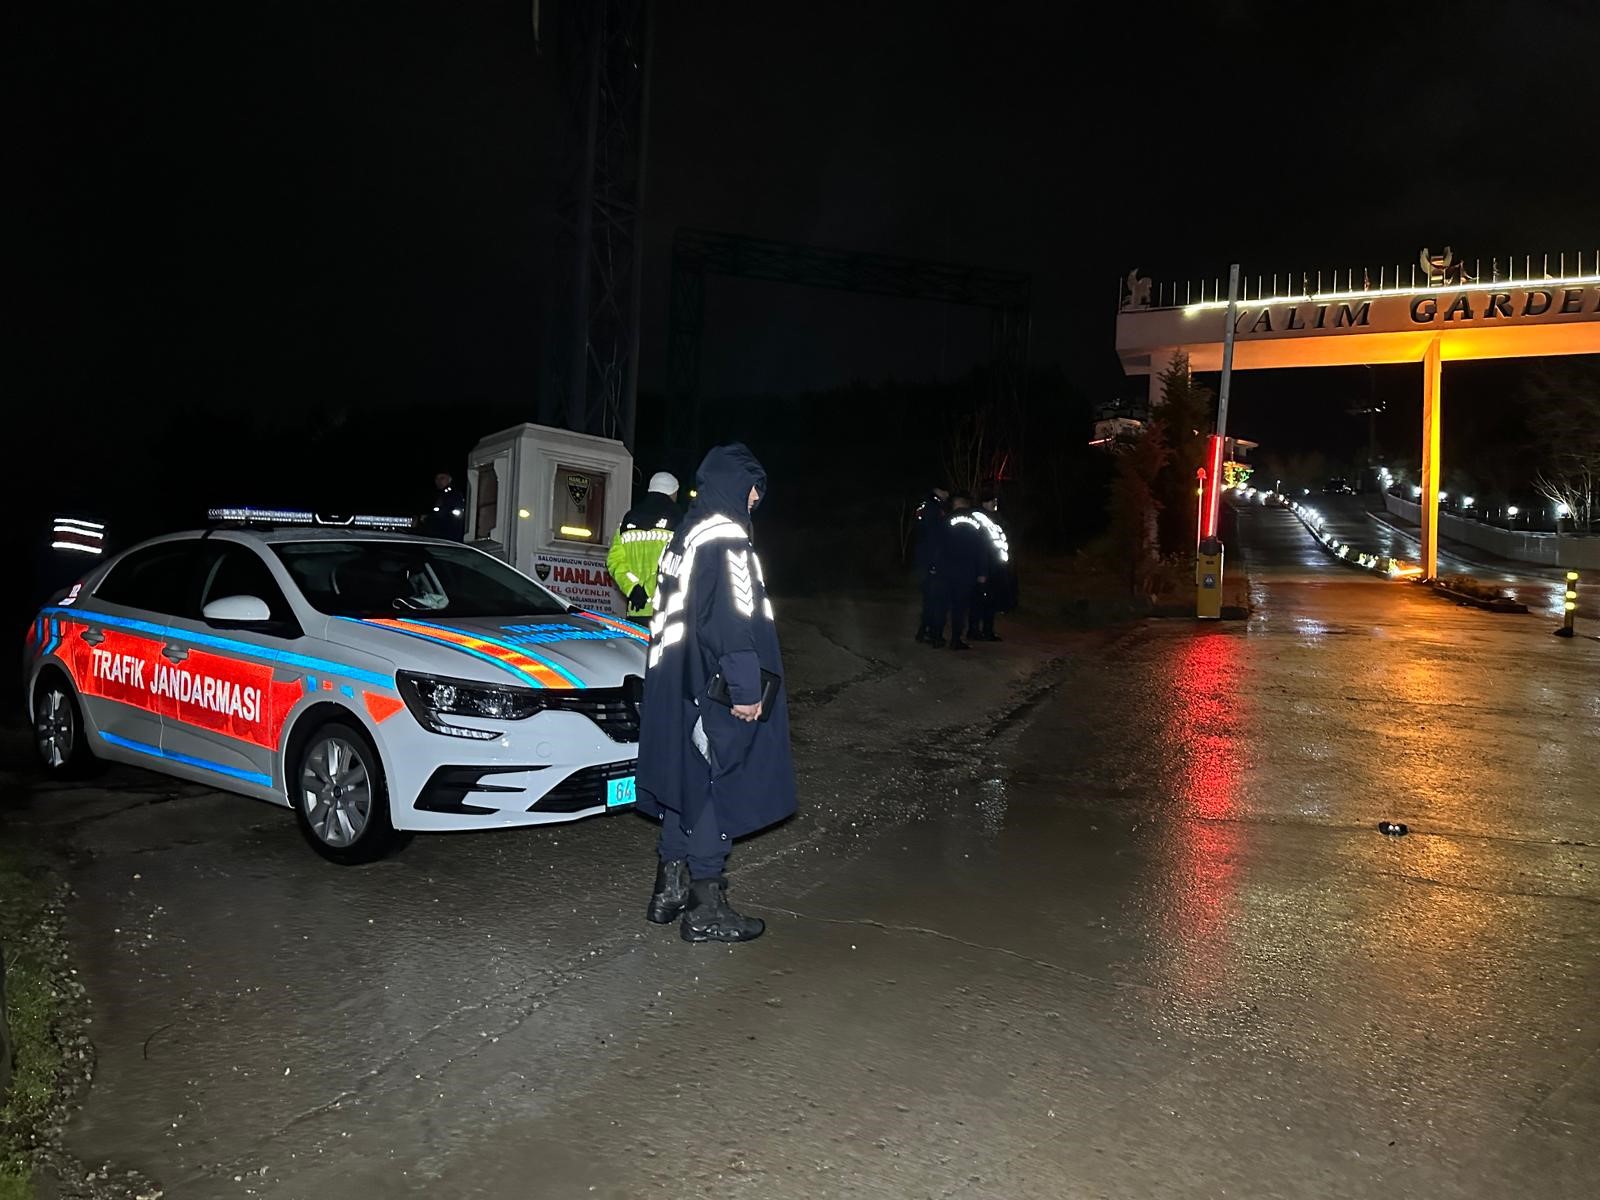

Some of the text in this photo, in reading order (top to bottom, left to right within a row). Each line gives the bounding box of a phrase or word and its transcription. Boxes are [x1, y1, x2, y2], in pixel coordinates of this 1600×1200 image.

[1232, 287, 1600, 334] YALIM GARDE
[538, 555, 606, 568] SALONUMUZUN GÜVENL
[545, 583, 562, 592] ZEL
[149, 663, 261, 723] JANDARMASI
